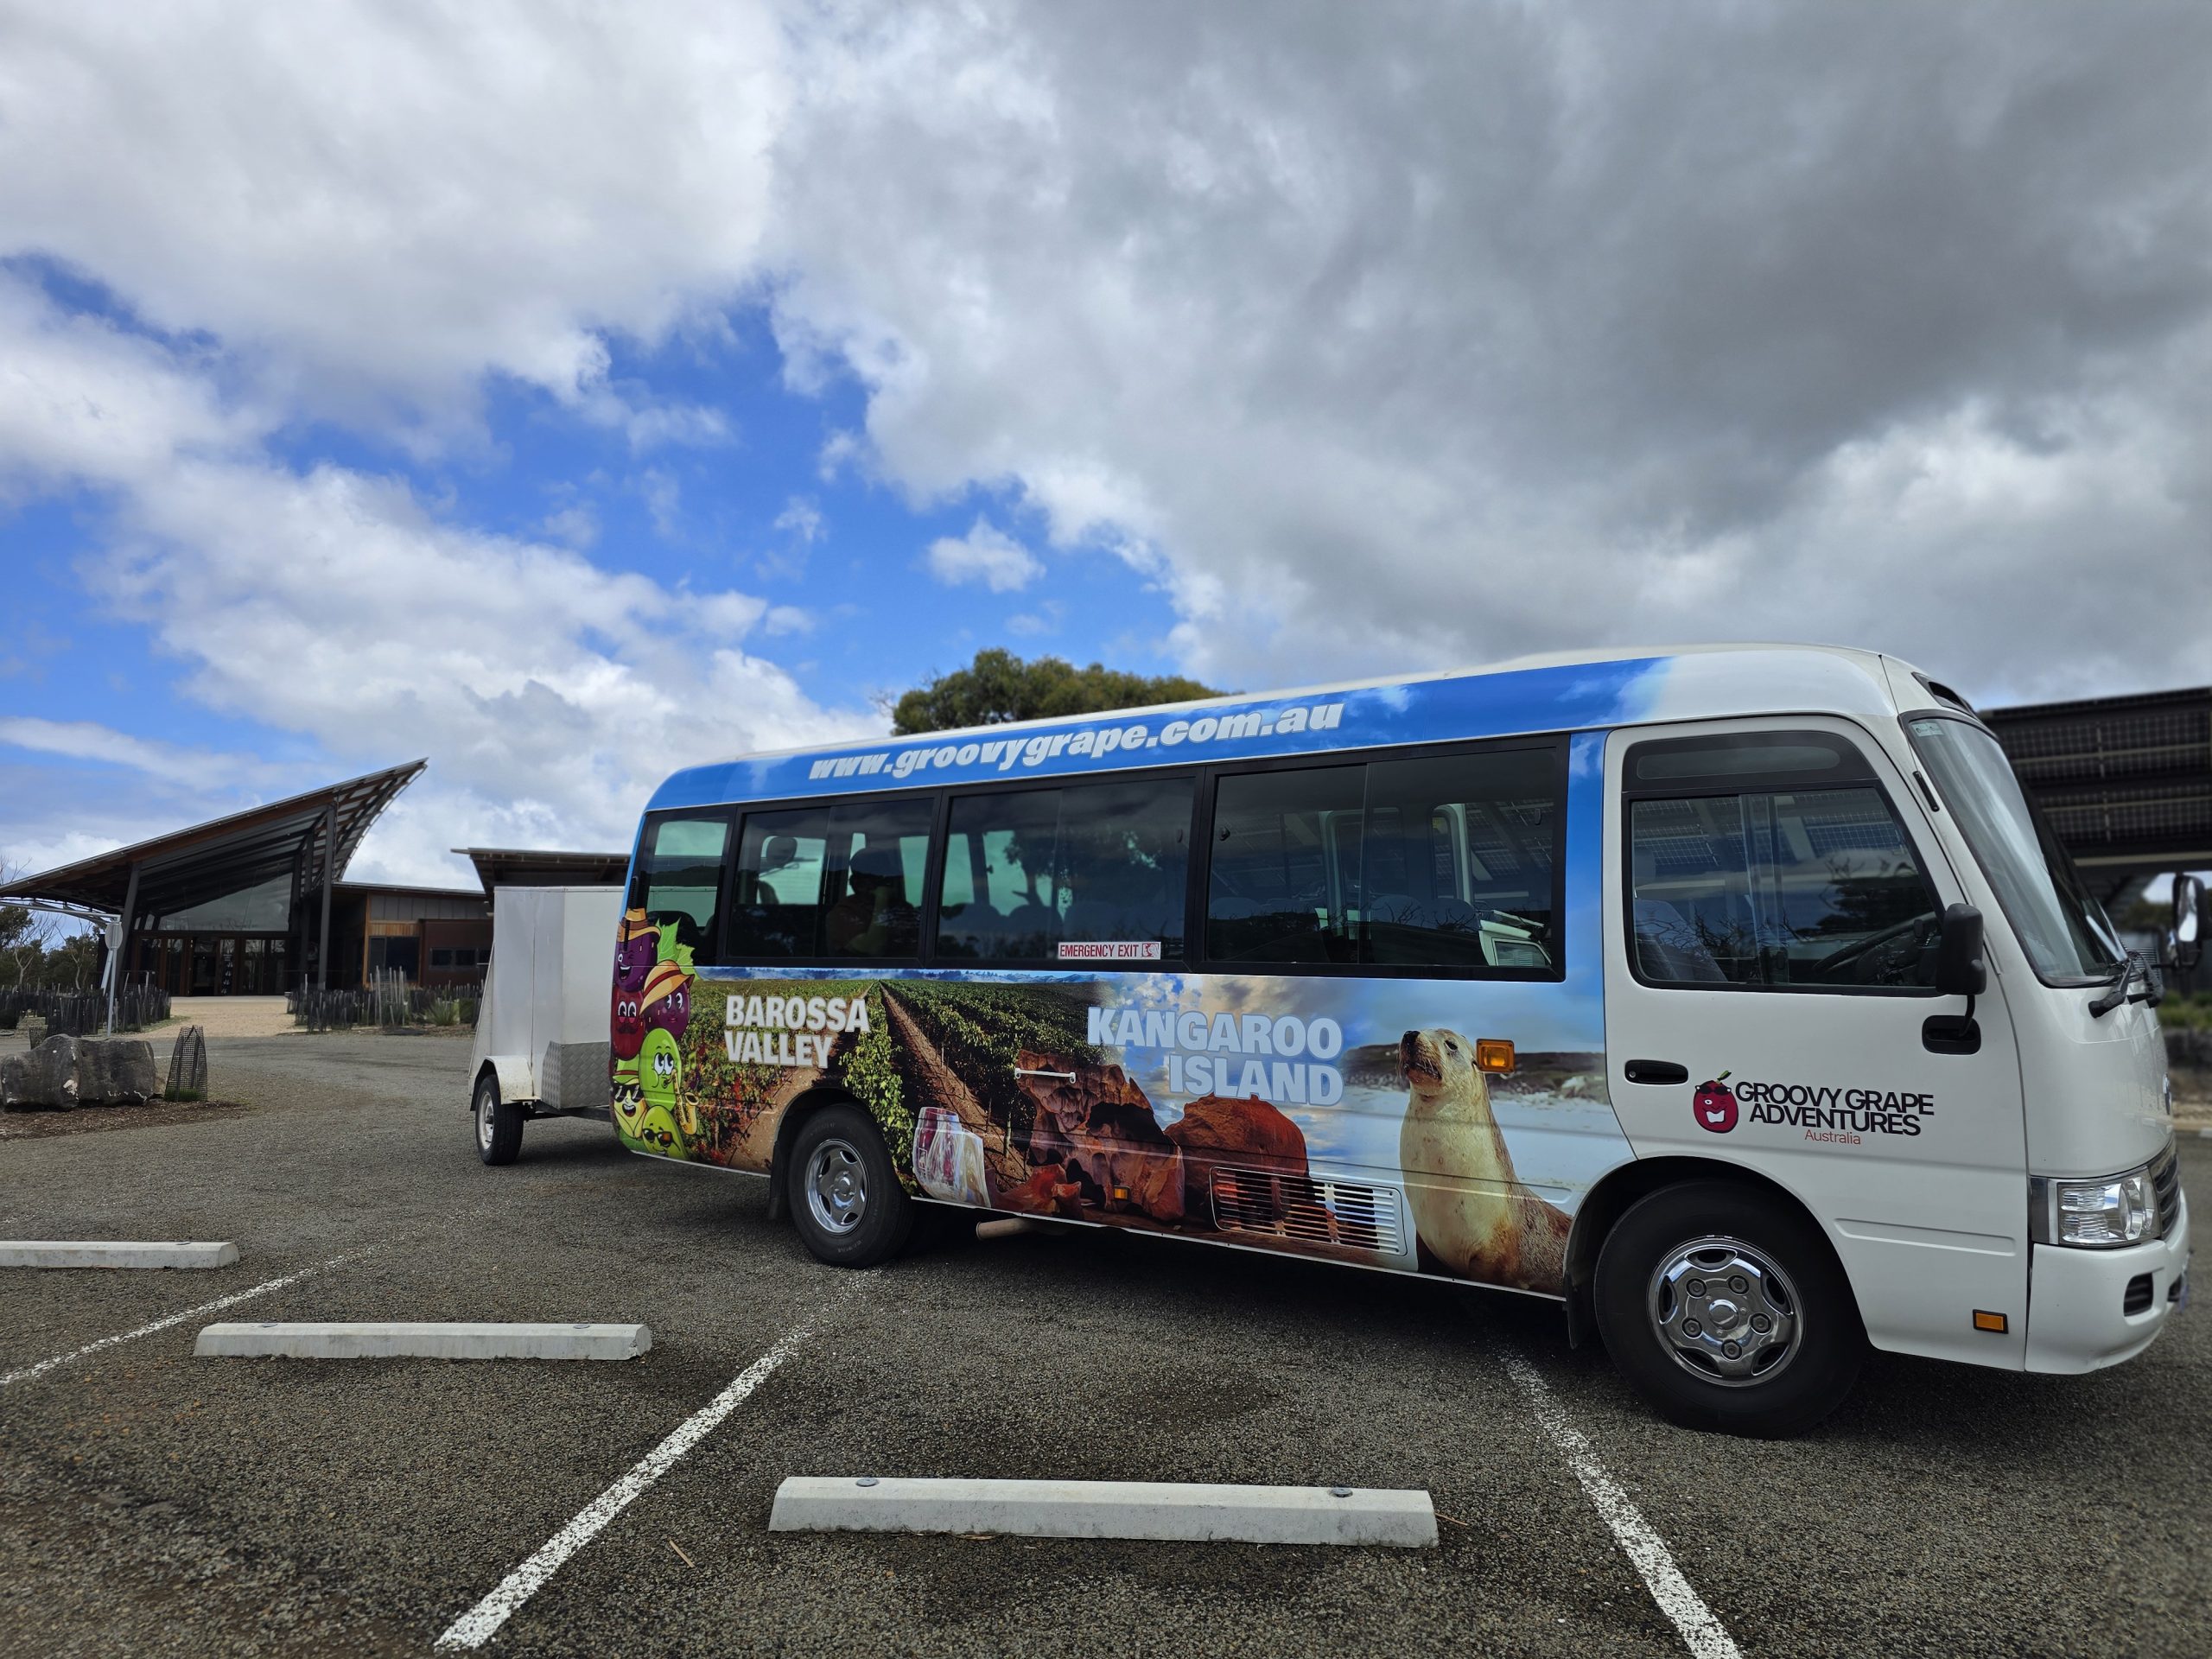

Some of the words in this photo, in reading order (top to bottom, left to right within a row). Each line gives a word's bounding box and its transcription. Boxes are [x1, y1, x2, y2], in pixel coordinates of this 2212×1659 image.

[808, 702, 1344, 780] www.groovygrape.com.au
[1059, 944, 1115, 957] EMERGENCY
[1117, 944, 1139, 957] EXIT
[725, 995, 871, 1033] BAROSSA
[1087, 1006, 1343, 1059] KANGAROO
[723, 1030, 833, 1069] VALLEY
[1168, 1053, 1344, 1107] ISLAND
[1735, 1081, 1842, 1109] GROOVY
[1845, 1089, 1935, 1116] GRAPE
[1749, 1103, 1921, 1136] ADVENTURES
[1804, 1128, 1861, 1145] Australia
